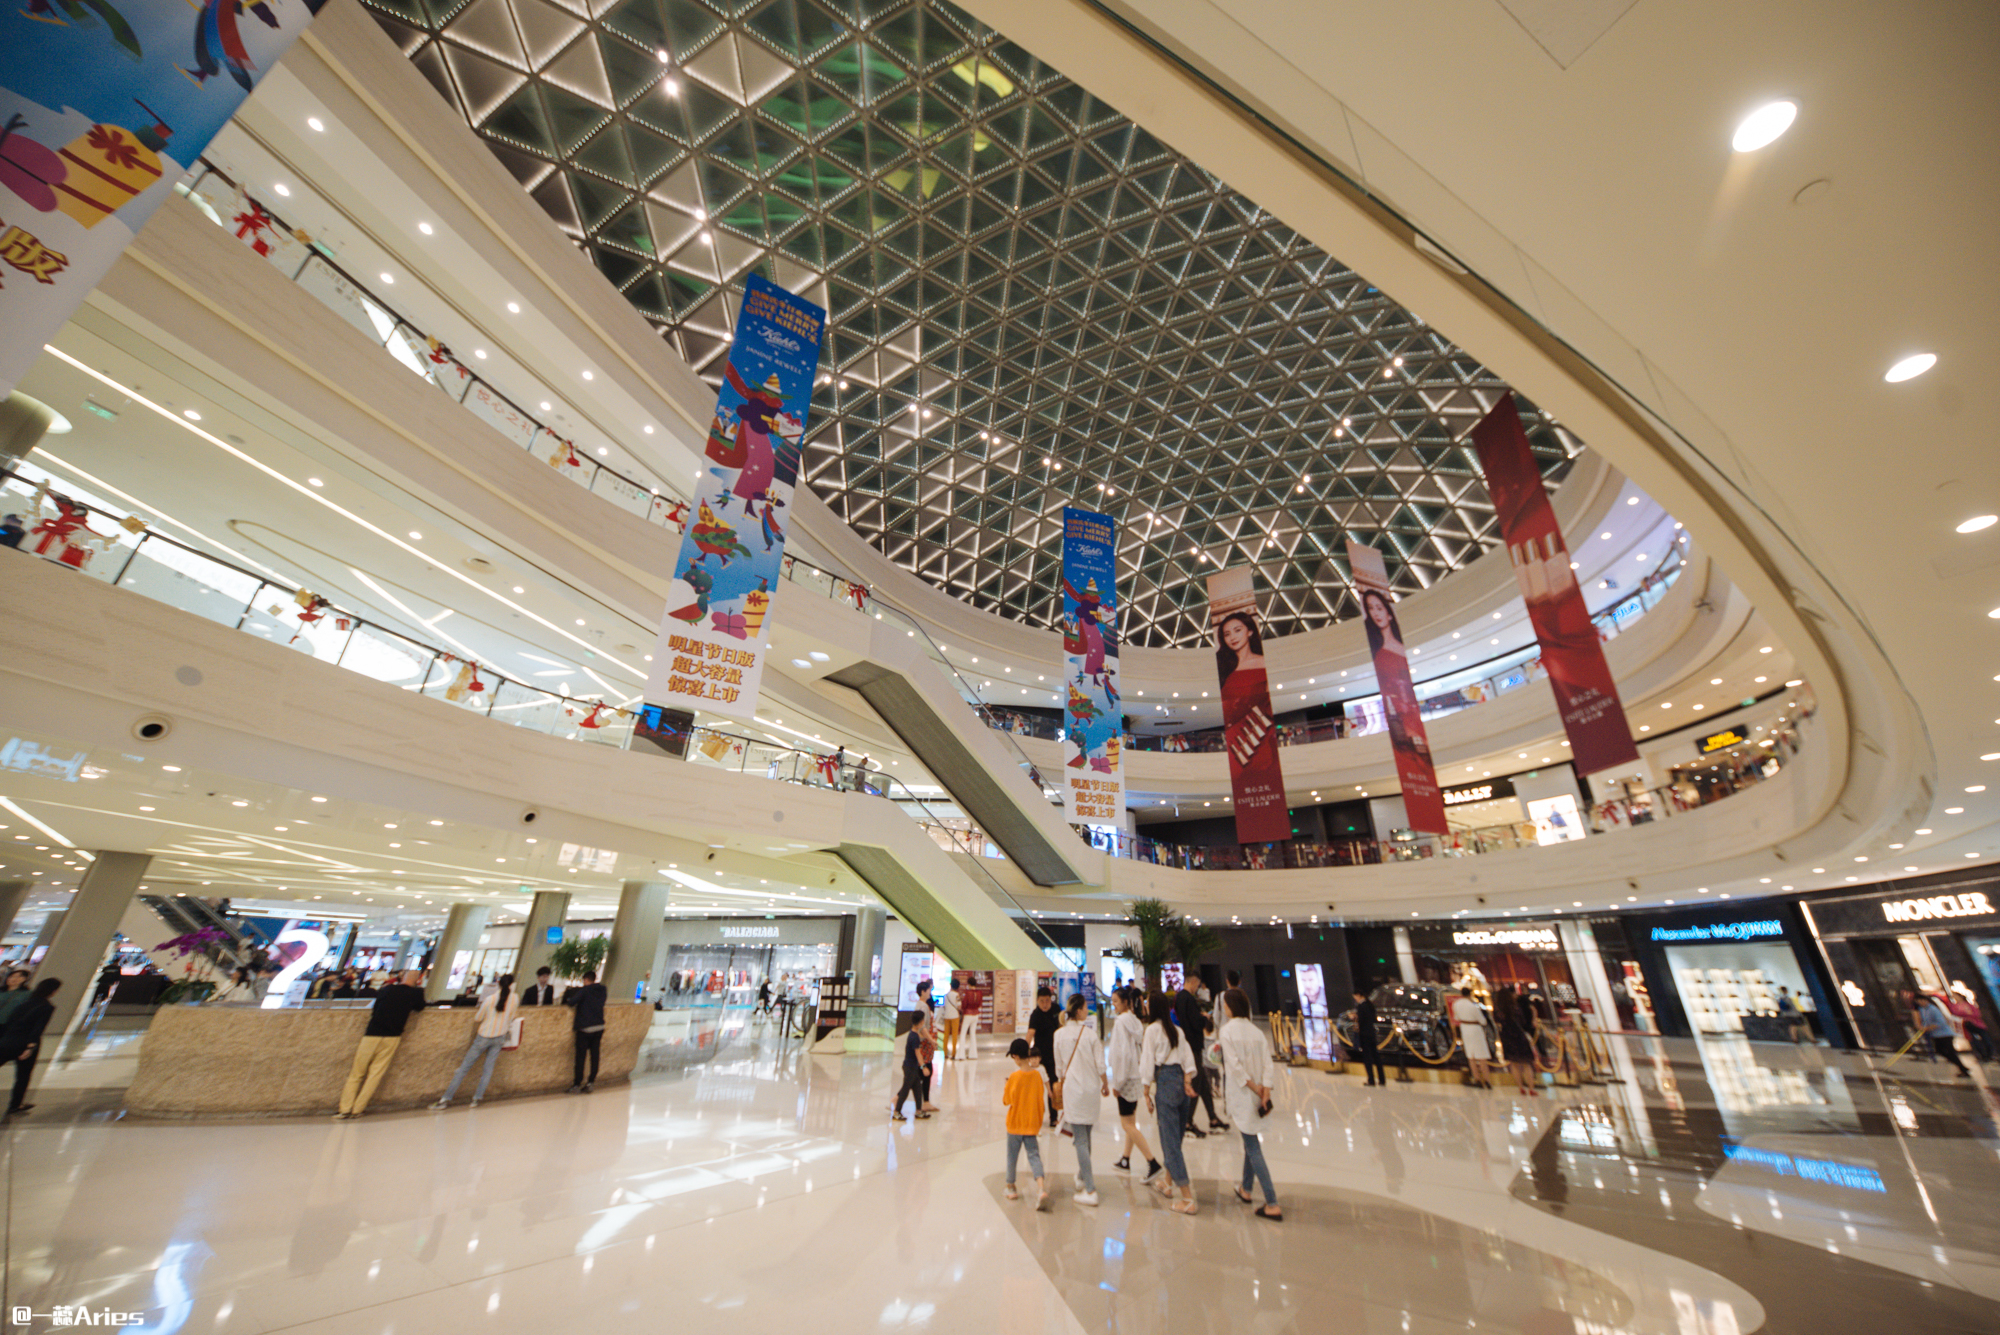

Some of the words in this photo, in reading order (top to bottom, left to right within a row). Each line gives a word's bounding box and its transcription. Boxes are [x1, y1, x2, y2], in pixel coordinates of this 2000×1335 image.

[744, 304, 773, 321] GIVE
[749, 296, 777, 314] GIVE
[757, 325, 801, 352] Kiehl's
[1065, 531, 1083, 539] GIVE
[1067, 524, 1084, 533] GIVE
[668, 634, 756, 668] 明星节日版
[670, 655, 743, 685] 超大容量
[668, 674, 741, 703] 惊喜上市
[1070, 778, 1120, 793] 明星节日版
[1075, 791, 1116, 806] 超大容量
[1442, 785, 1493, 805] BALLY
[1075, 804, 1116, 819] 惊喜上市
[1881, 891, 1996, 922] MONCLER
[723, 926, 780, 938] BALENCIAGA
[1651, 924, 1711, 941] Alexander
[1710, 919, 1783, 940] McQUEEN
